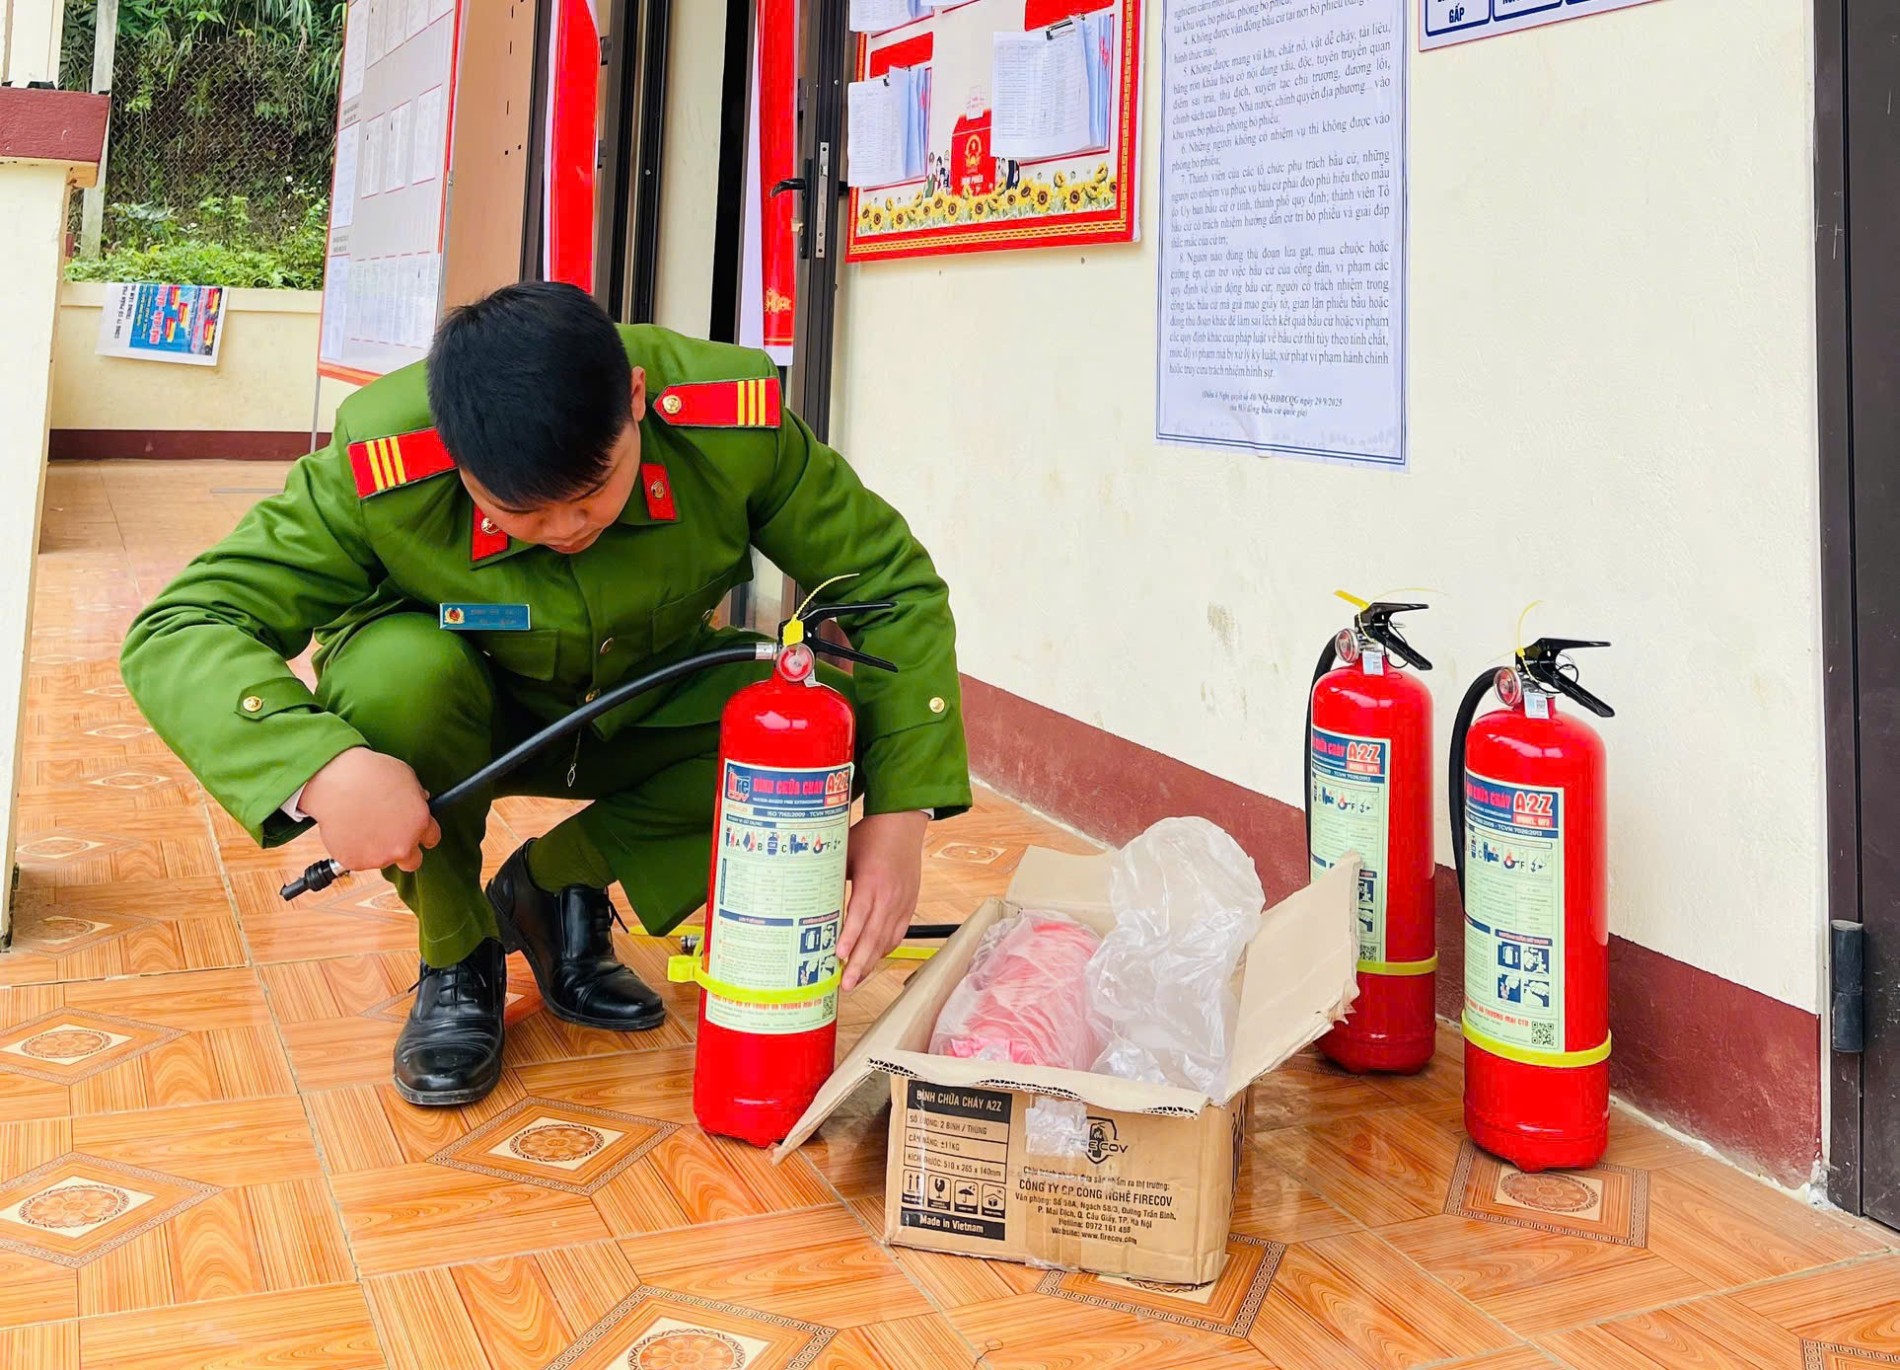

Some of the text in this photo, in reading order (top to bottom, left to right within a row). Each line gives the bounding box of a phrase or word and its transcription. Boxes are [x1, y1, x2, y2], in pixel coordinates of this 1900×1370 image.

[1449, 3, 1465, 23] GẤP
[1347, 742, 1380, 763] A2Z
[1514, 791, 1553, 816] A2Z
[757, 843, 763, 851] B
[781, 845, 787, 853] C
[916, 1089, 1002, 1112] BÌNH CHỮA CHÁY A2Z
[940, 1121, 945, 1129] 2
[943, 1161, 955, 1170] 510
[1019, 1177, 1045, 1192] CÔNG
[1048, 1182, 1059, 1194] TY
[1061, 1185, 1074, 1195] CP
[1076, 1186, 1102, 1199] CÔNG
[1133, 1193, 1172, 1207] FIRECOV
[1080, 1201, 1100, 1211] Ngách
[920, 1213, 984, 1233] Made in Vietnam
[1085, 1221, 1102, 1231] 0972
